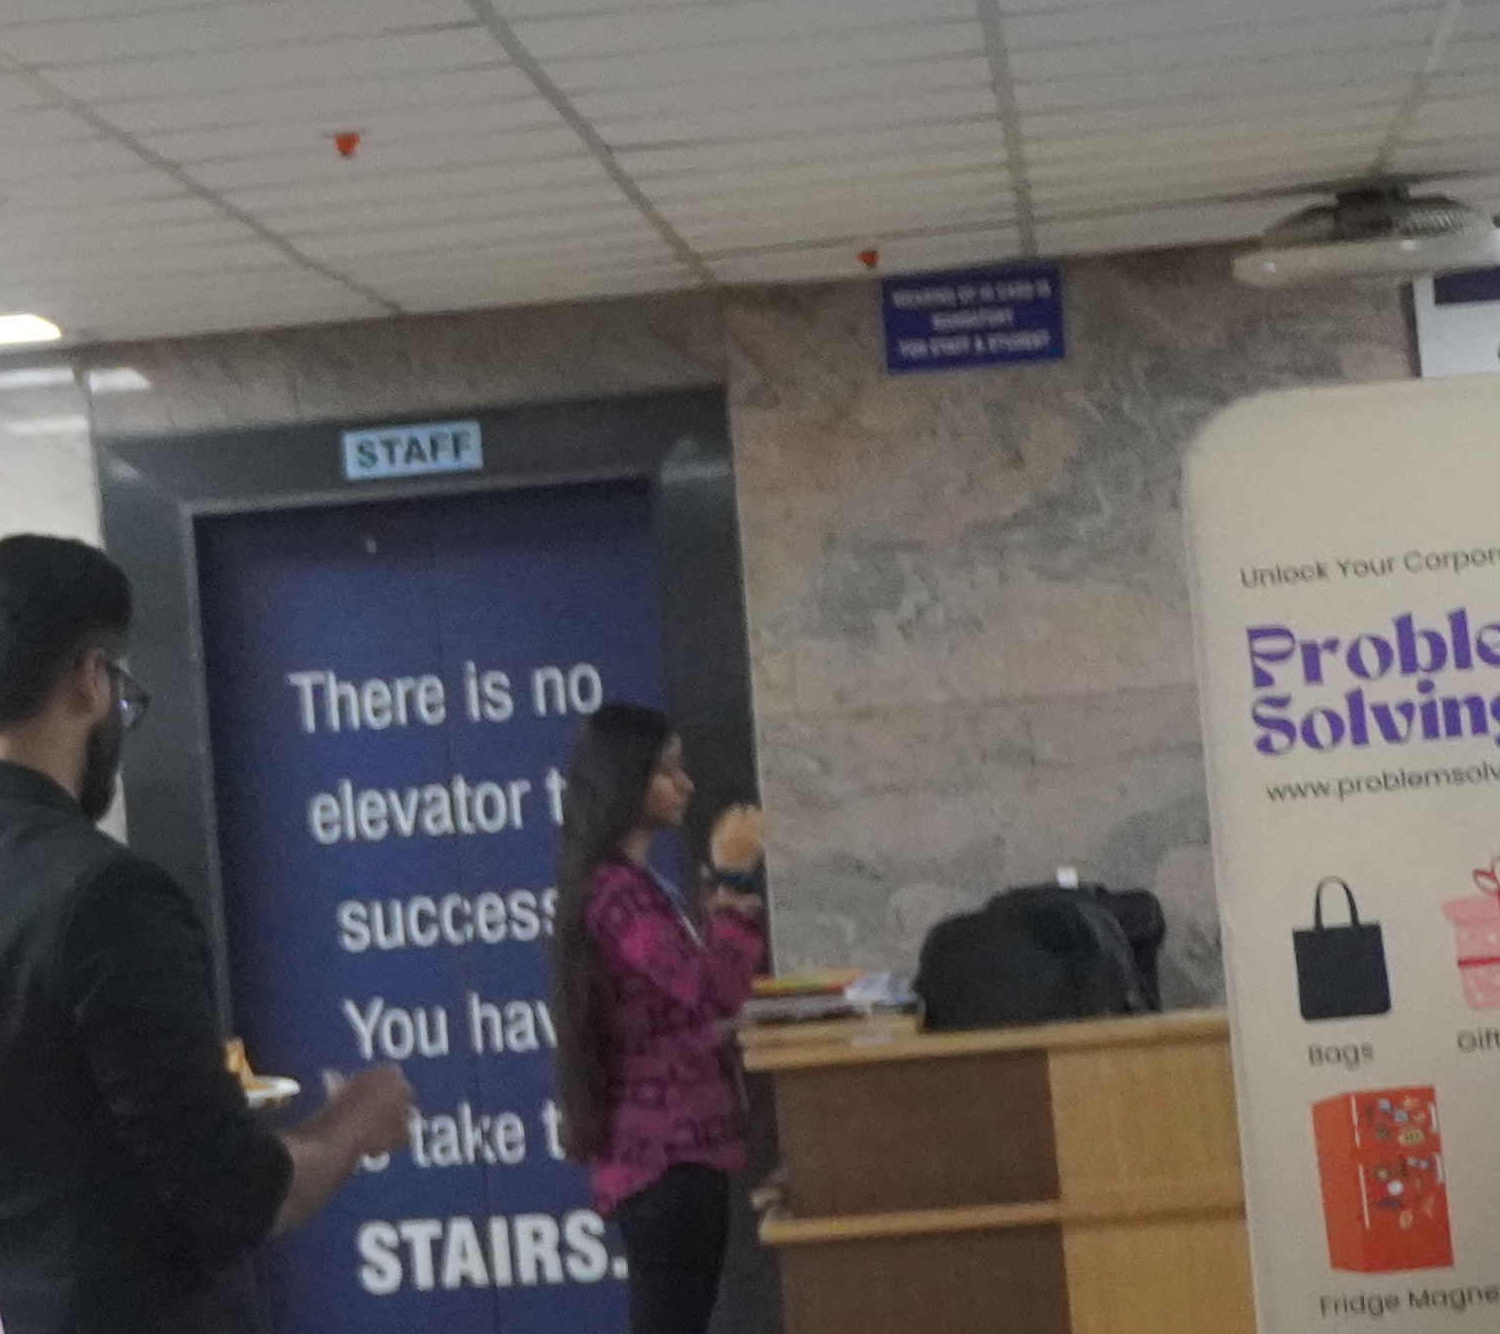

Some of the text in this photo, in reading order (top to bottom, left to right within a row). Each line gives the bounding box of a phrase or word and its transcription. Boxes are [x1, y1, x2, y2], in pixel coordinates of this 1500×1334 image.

[356, 430, 472, 471] STAFF
[1240, 559, 1329, 588] Unlock
[1336, 555, 1395, 578] Your
[288, 660, 603, 733] There is no
[308, 772, 531, 846] elevator
[342, 996, 449, 1060] You
[1308, 1042, 1374, 1069] Bags
[409, 1101, 526, 1167] take
[357, 1209, 629, 1295] STAIRS.
[1320, 1292, 1400, 1318] Fridge
